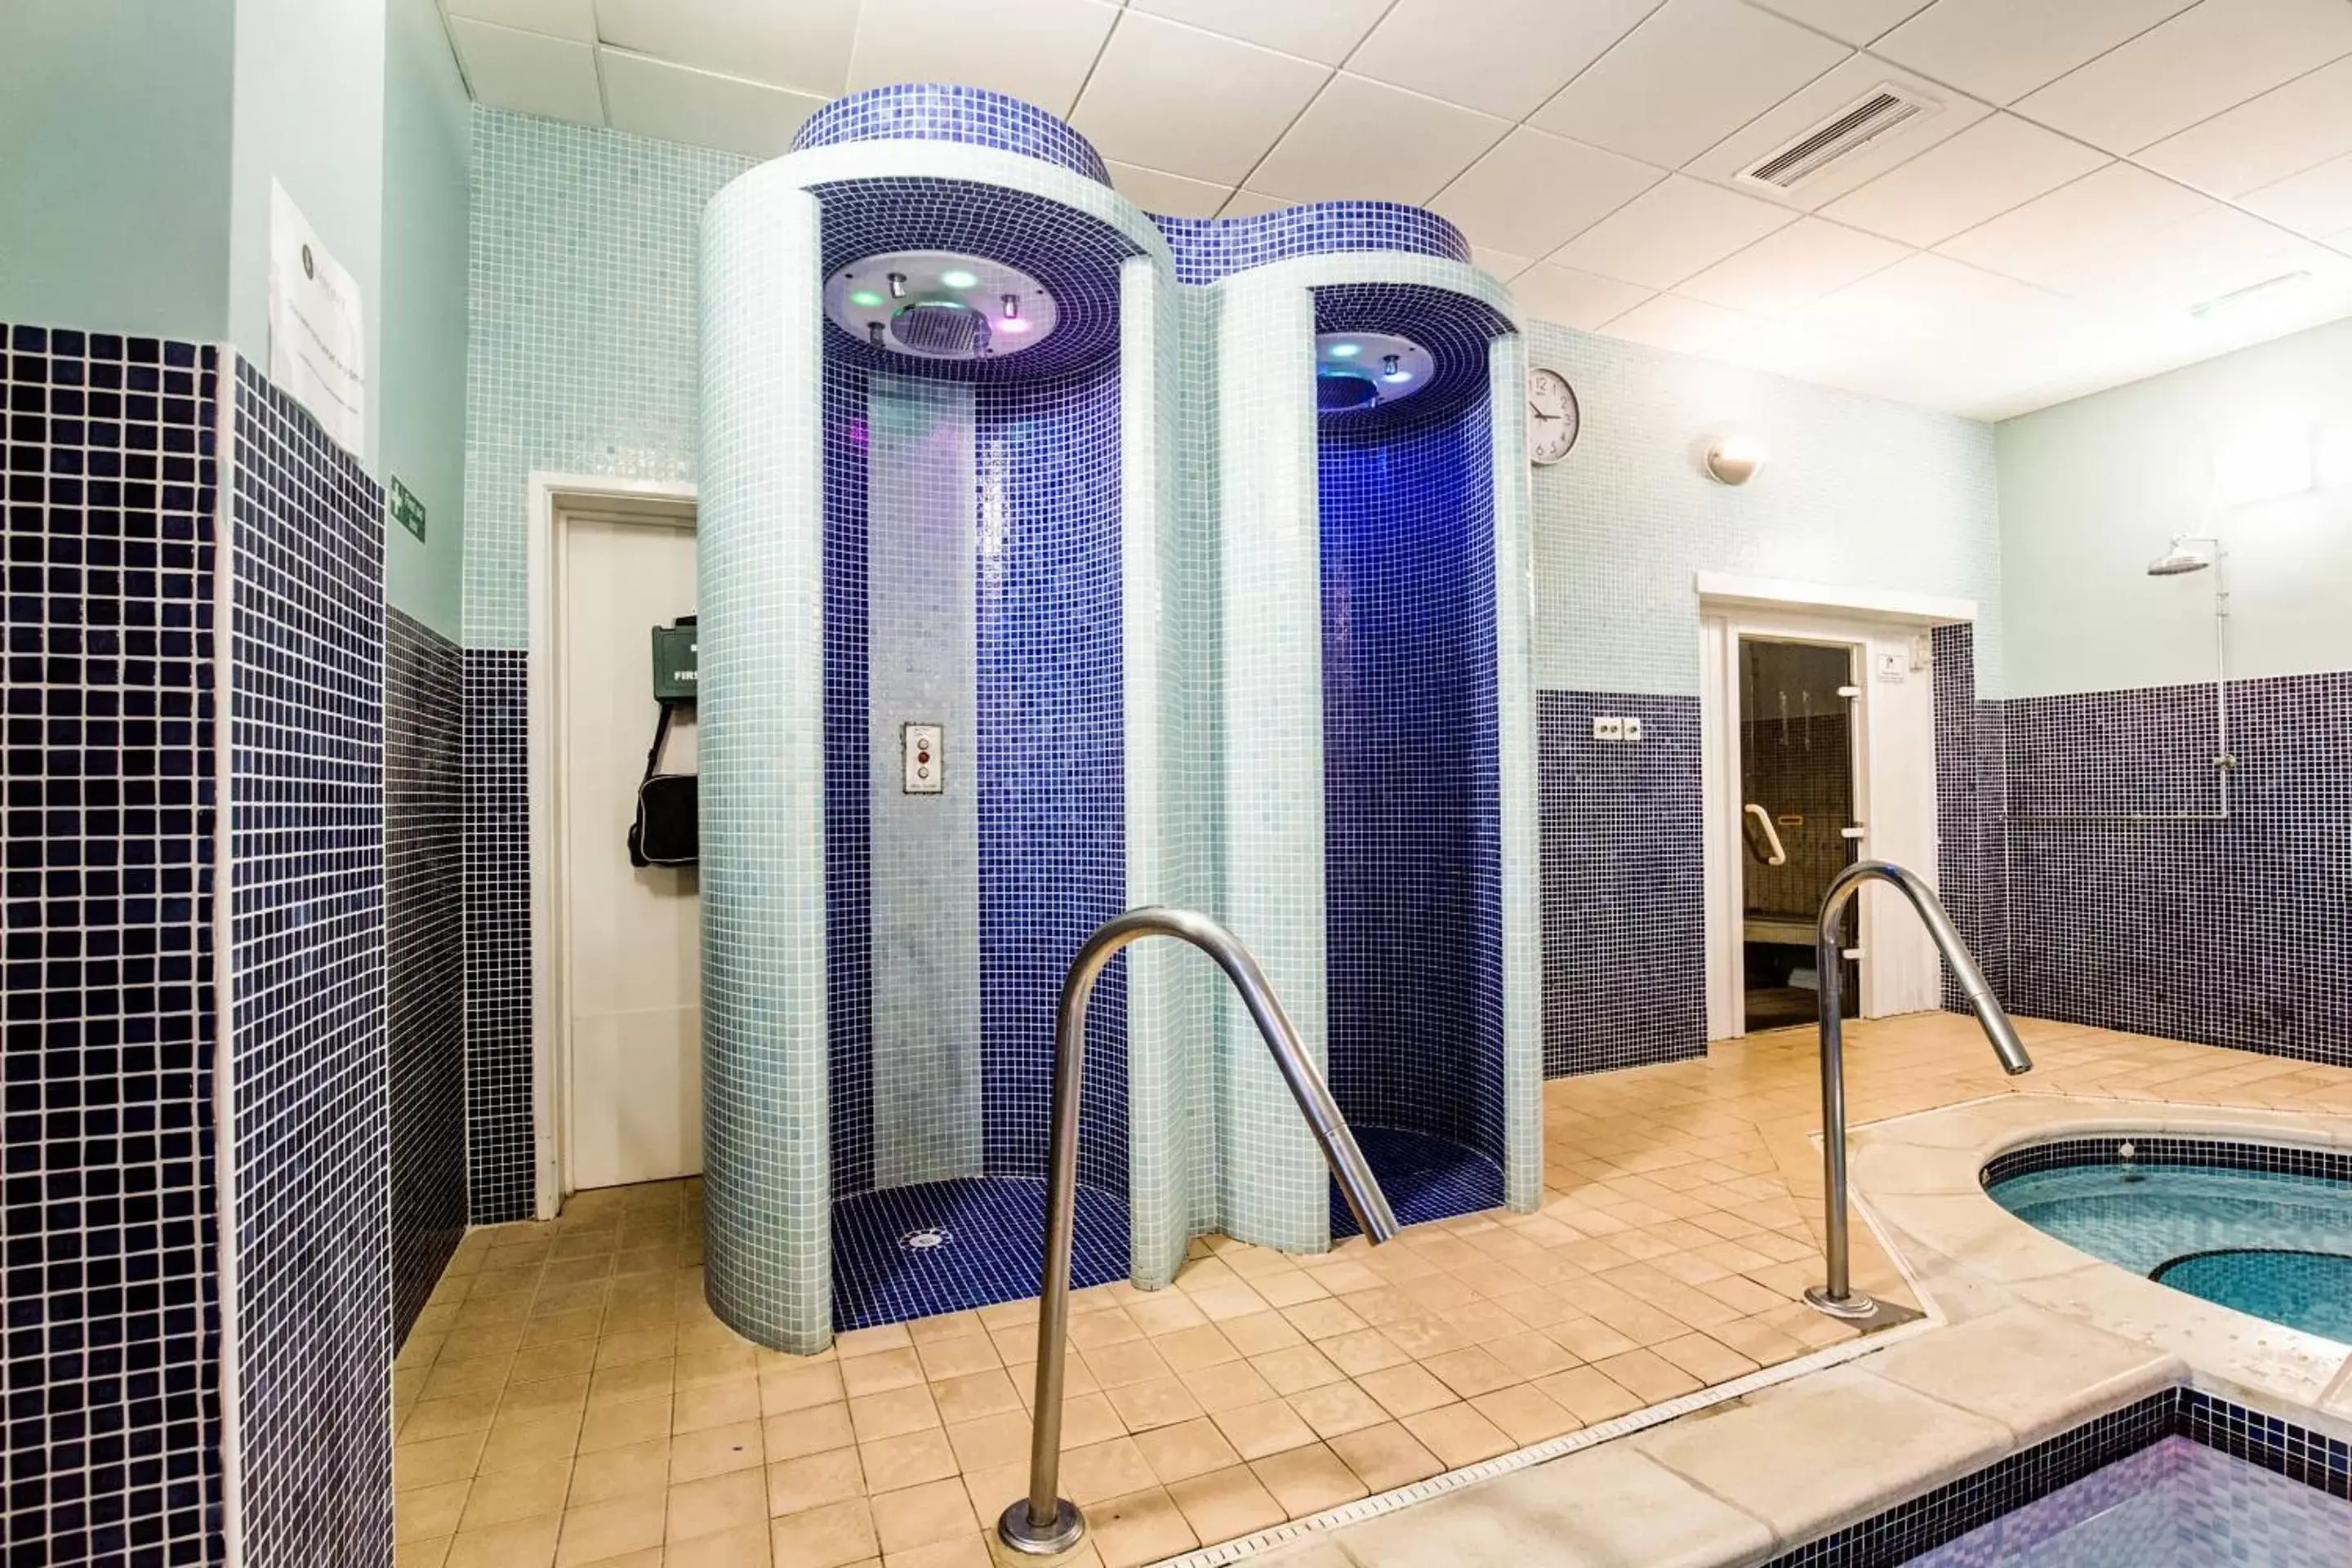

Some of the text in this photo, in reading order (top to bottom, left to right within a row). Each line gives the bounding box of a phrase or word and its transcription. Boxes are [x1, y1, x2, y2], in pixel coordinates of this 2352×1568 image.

[1535, 377, 1547, 391] 12
[1552, 383, 1556, 396] 1
[1560, 396, 1567, 409] 2
[1536, 443, 1544, 456] 6
